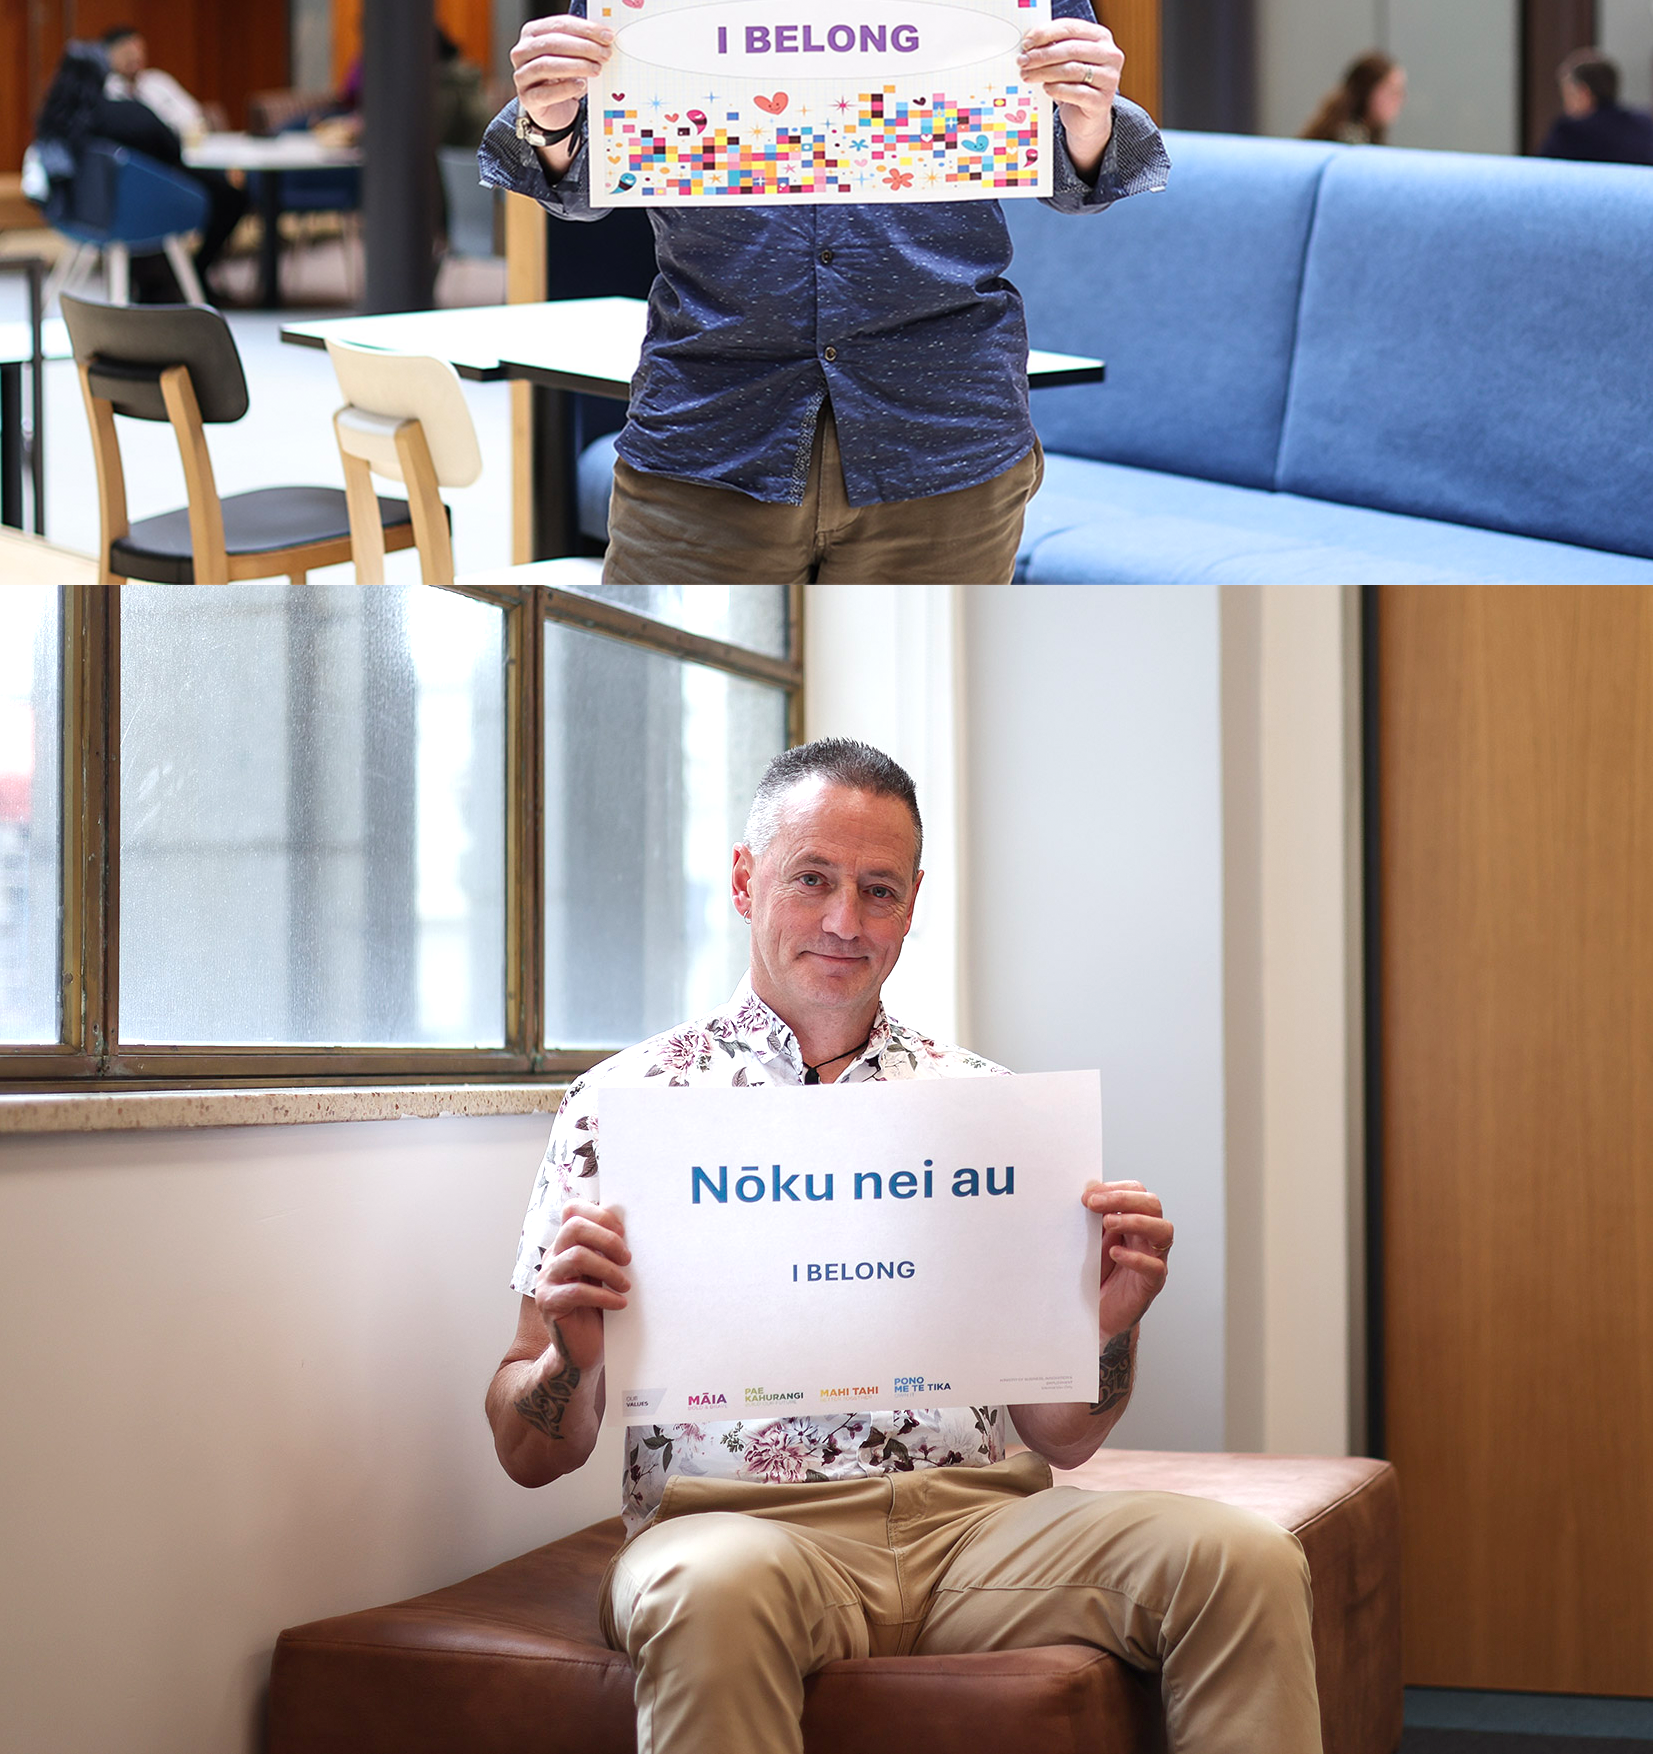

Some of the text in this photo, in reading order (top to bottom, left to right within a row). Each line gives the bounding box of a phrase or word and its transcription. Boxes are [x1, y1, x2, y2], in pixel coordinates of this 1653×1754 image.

[717, 24, 920, 54] I BELONG
[691, 1159, 1015, 1204] Nōku nei au
[792, 1260, 916, 1282] I BELONG
[894, 1376, 924, 1385] PONO
[745, 1387, 764, 1395] PAE
[820, 1386, 879, 1397] MAHI TAHI
[894, 1382, 951, 1393] ME TE TIKA
[688, 1392, 727, 1406] MĀIA
[745, 1392, 804, 1402] KAHURANGI
